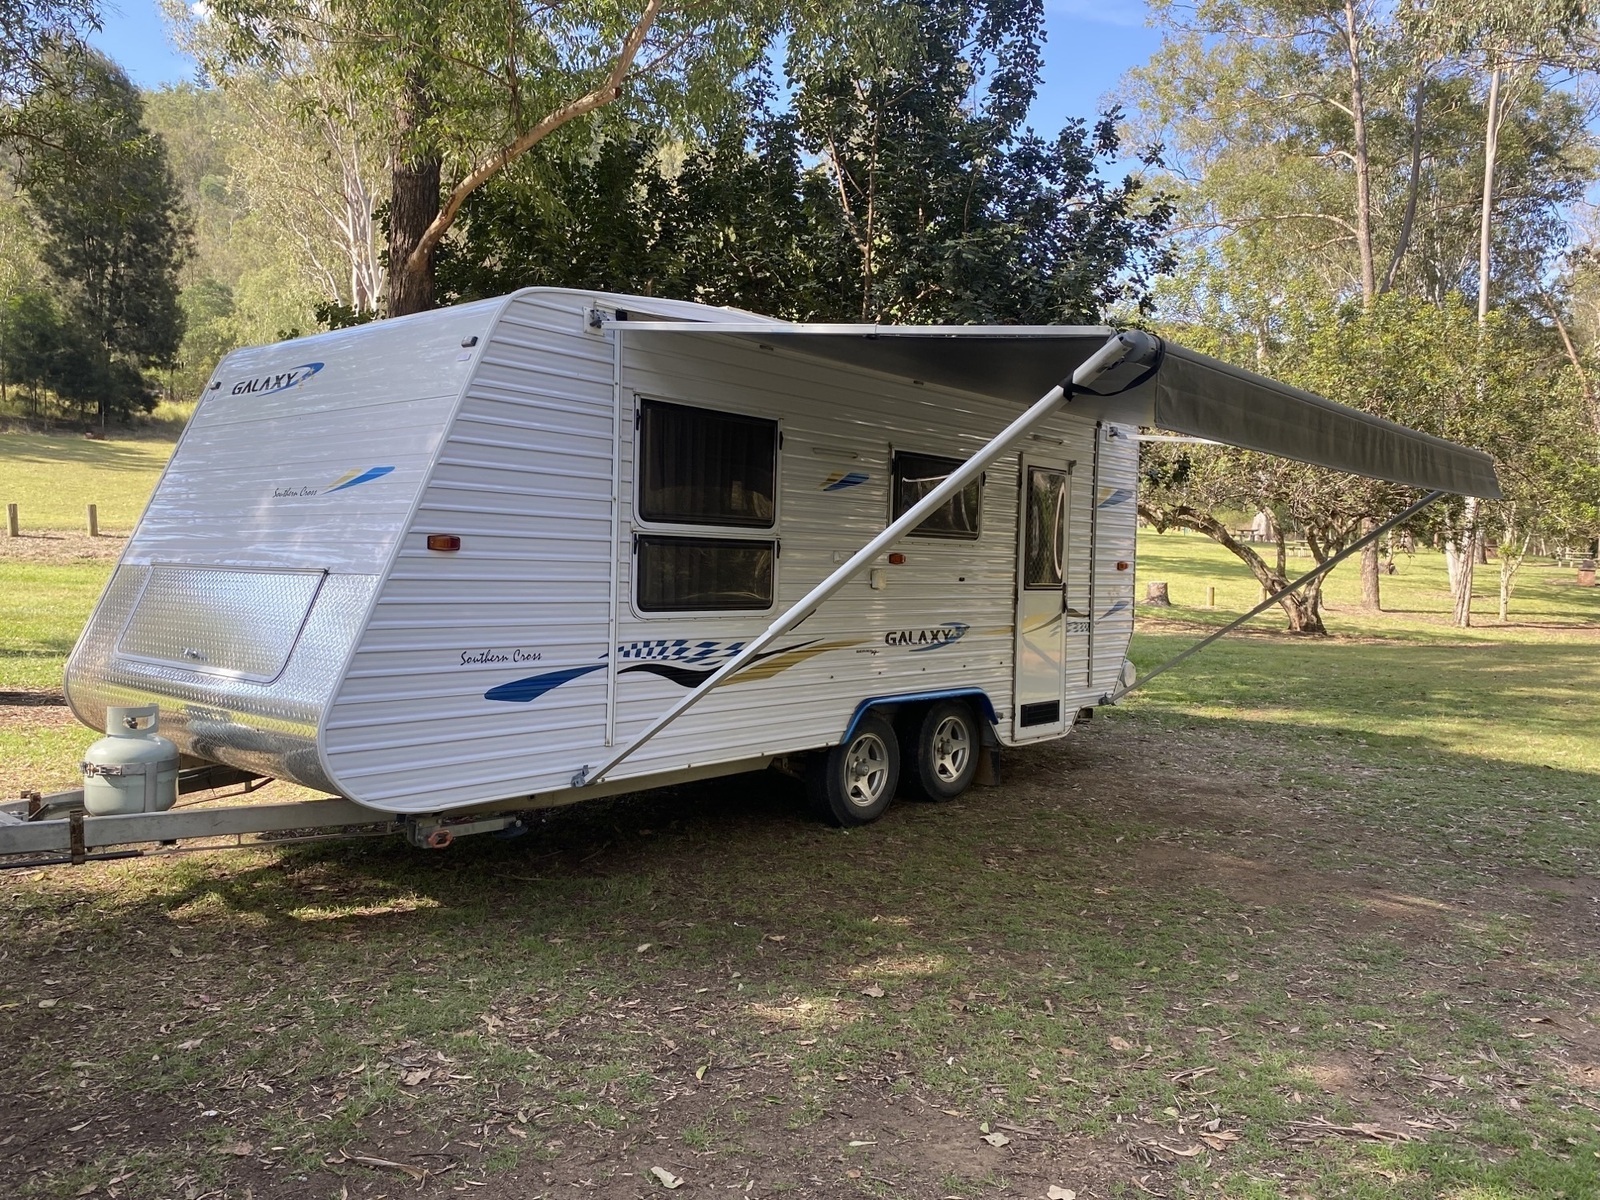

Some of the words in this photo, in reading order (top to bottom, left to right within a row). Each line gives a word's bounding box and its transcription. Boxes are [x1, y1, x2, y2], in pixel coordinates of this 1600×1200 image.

[231, 371, 298, 396] GALAXY
[272, 488, 298, 498] Southern
[299, 486, 318, 497] Cross
[885, 629, 952, 646] GALAXY
[460, 649, 509, 666] Southern
[513, 649, 543, 663] Cross
